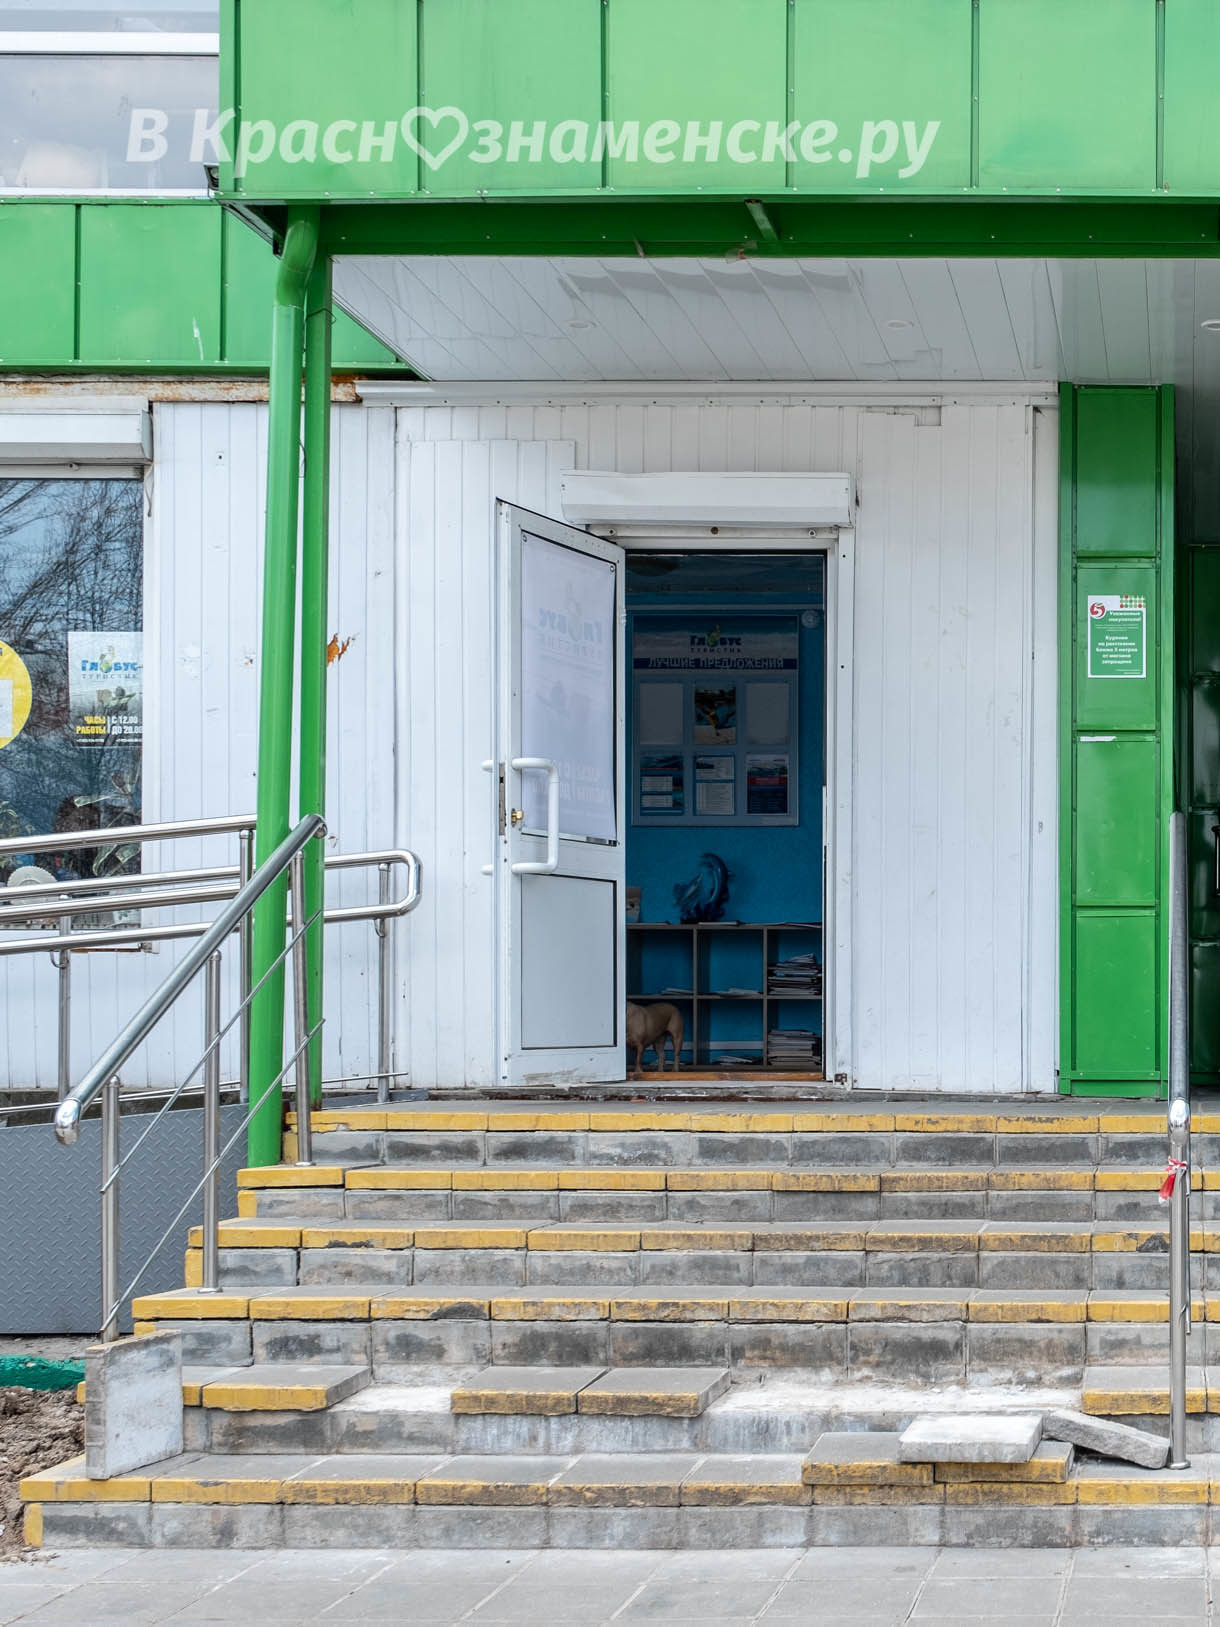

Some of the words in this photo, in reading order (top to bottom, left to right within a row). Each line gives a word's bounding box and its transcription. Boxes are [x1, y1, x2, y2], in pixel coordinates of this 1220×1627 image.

[648, 657, 695, 668] ЛУЧШИЕ
[699, 657, 784, 668] ПРЕДЛОЖЕНИЯ
[84, 715, 106, 725] ЧАСЫ
[75, 725, 106, 735] РАБОТЫ
[111, 725, 122, 736] ДО
